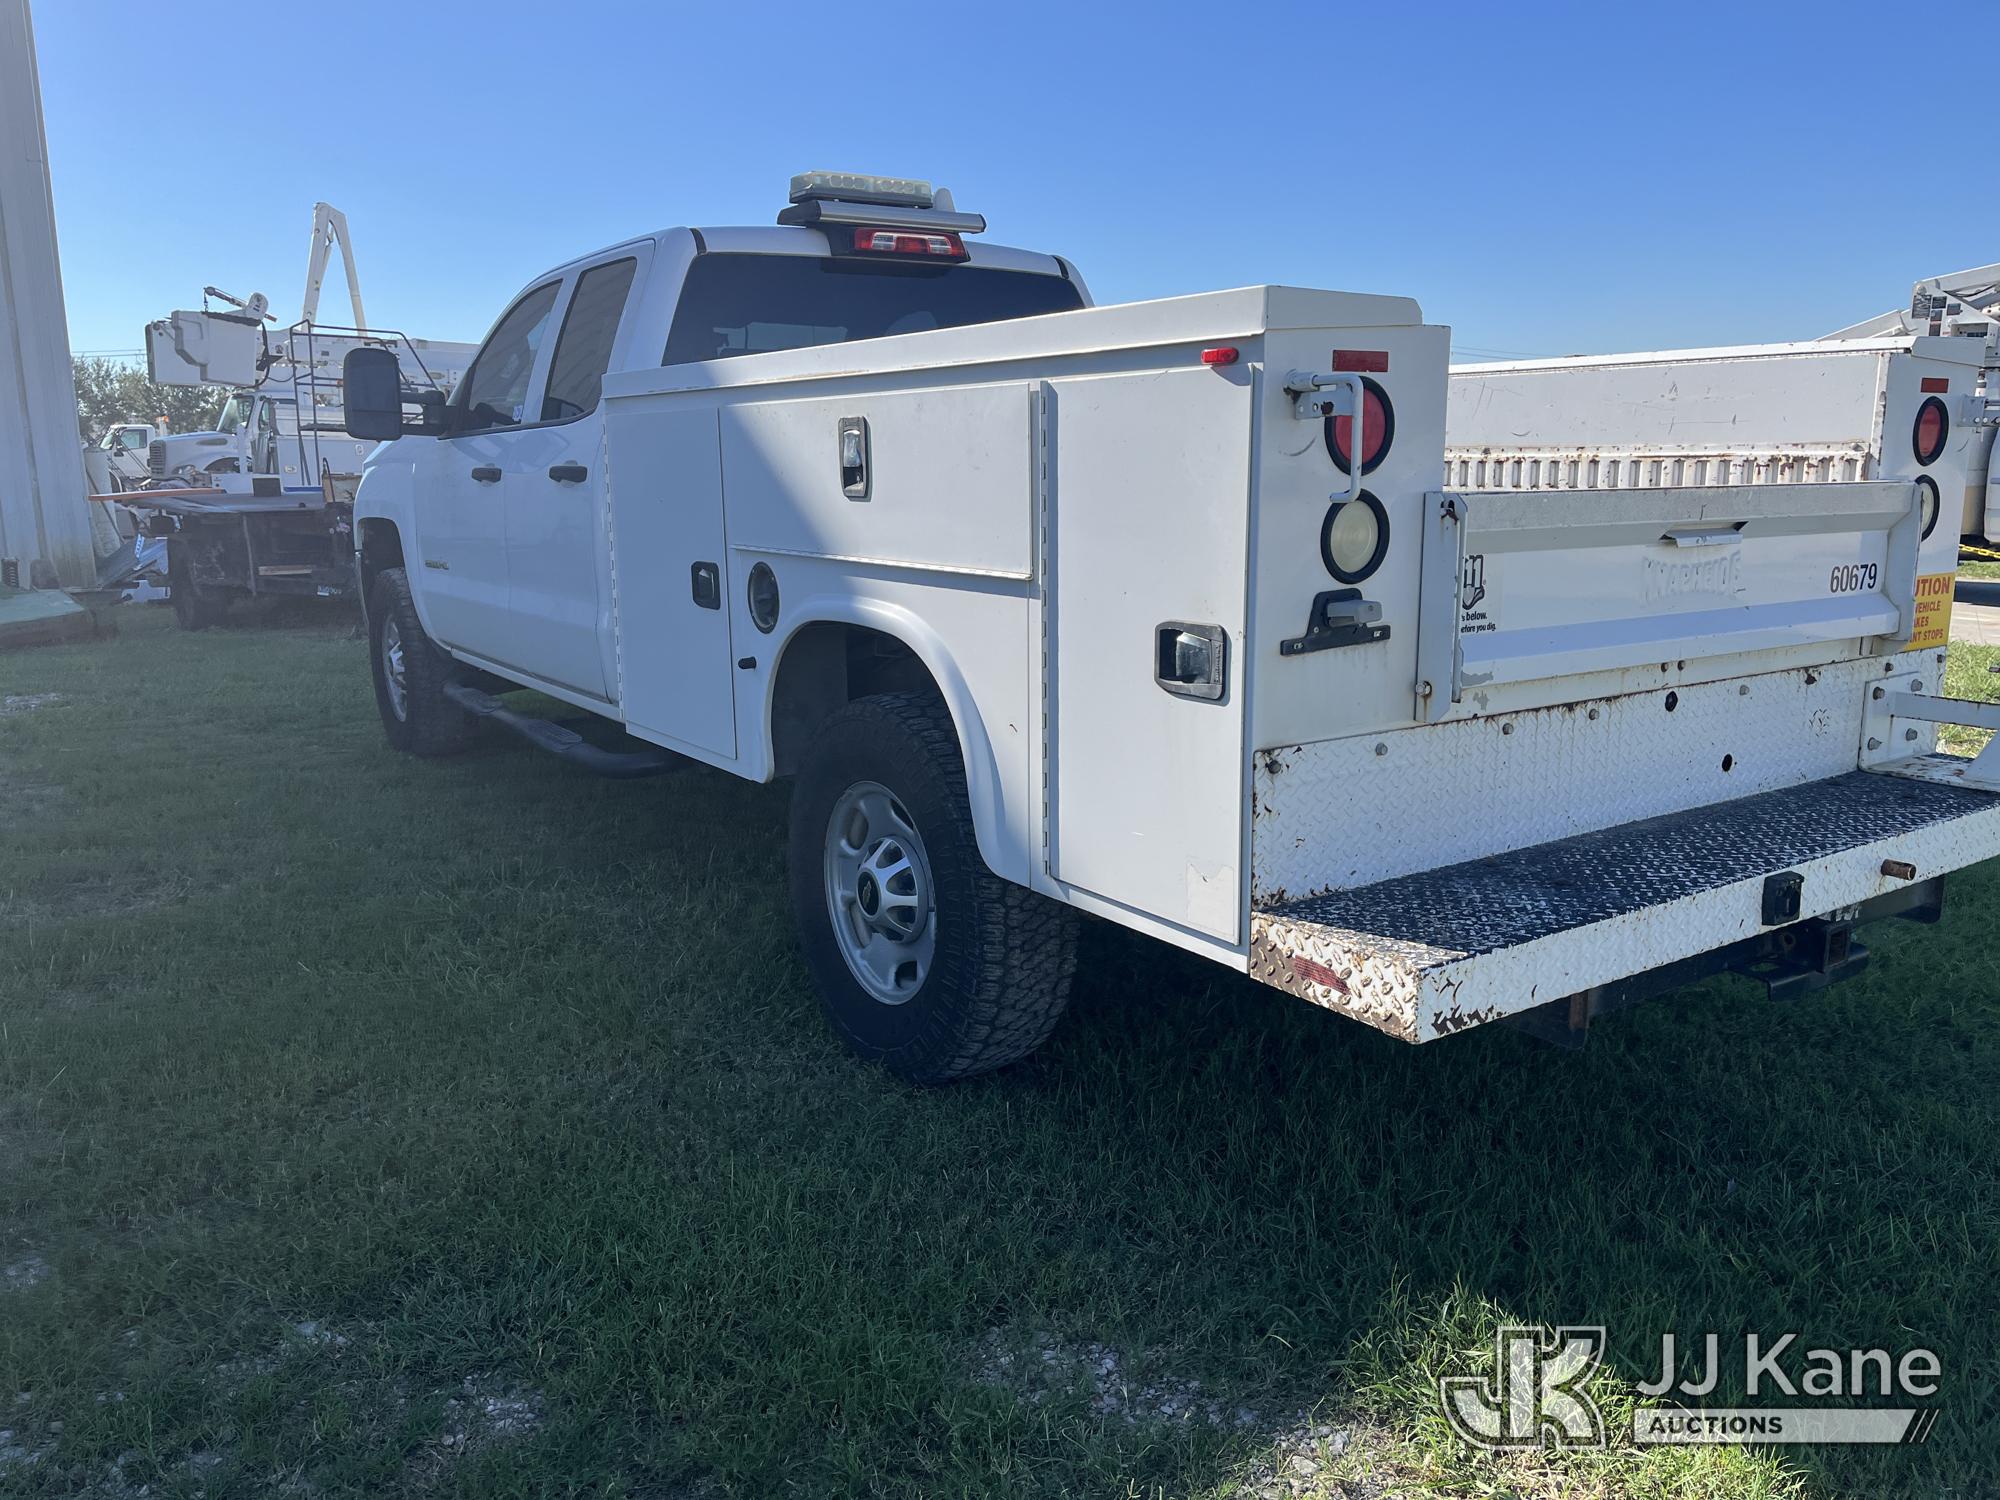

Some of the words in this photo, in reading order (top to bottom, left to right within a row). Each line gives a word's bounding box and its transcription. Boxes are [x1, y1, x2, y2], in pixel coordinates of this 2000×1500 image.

[1830, 562, 1878, 593] 60679
[1915, 577, 1951, 596] TION
[1914, 617, 1929, 628] KES
[1461, 624, 1475, 634] efore
[1923, 629, 1943, 640] STOPS
